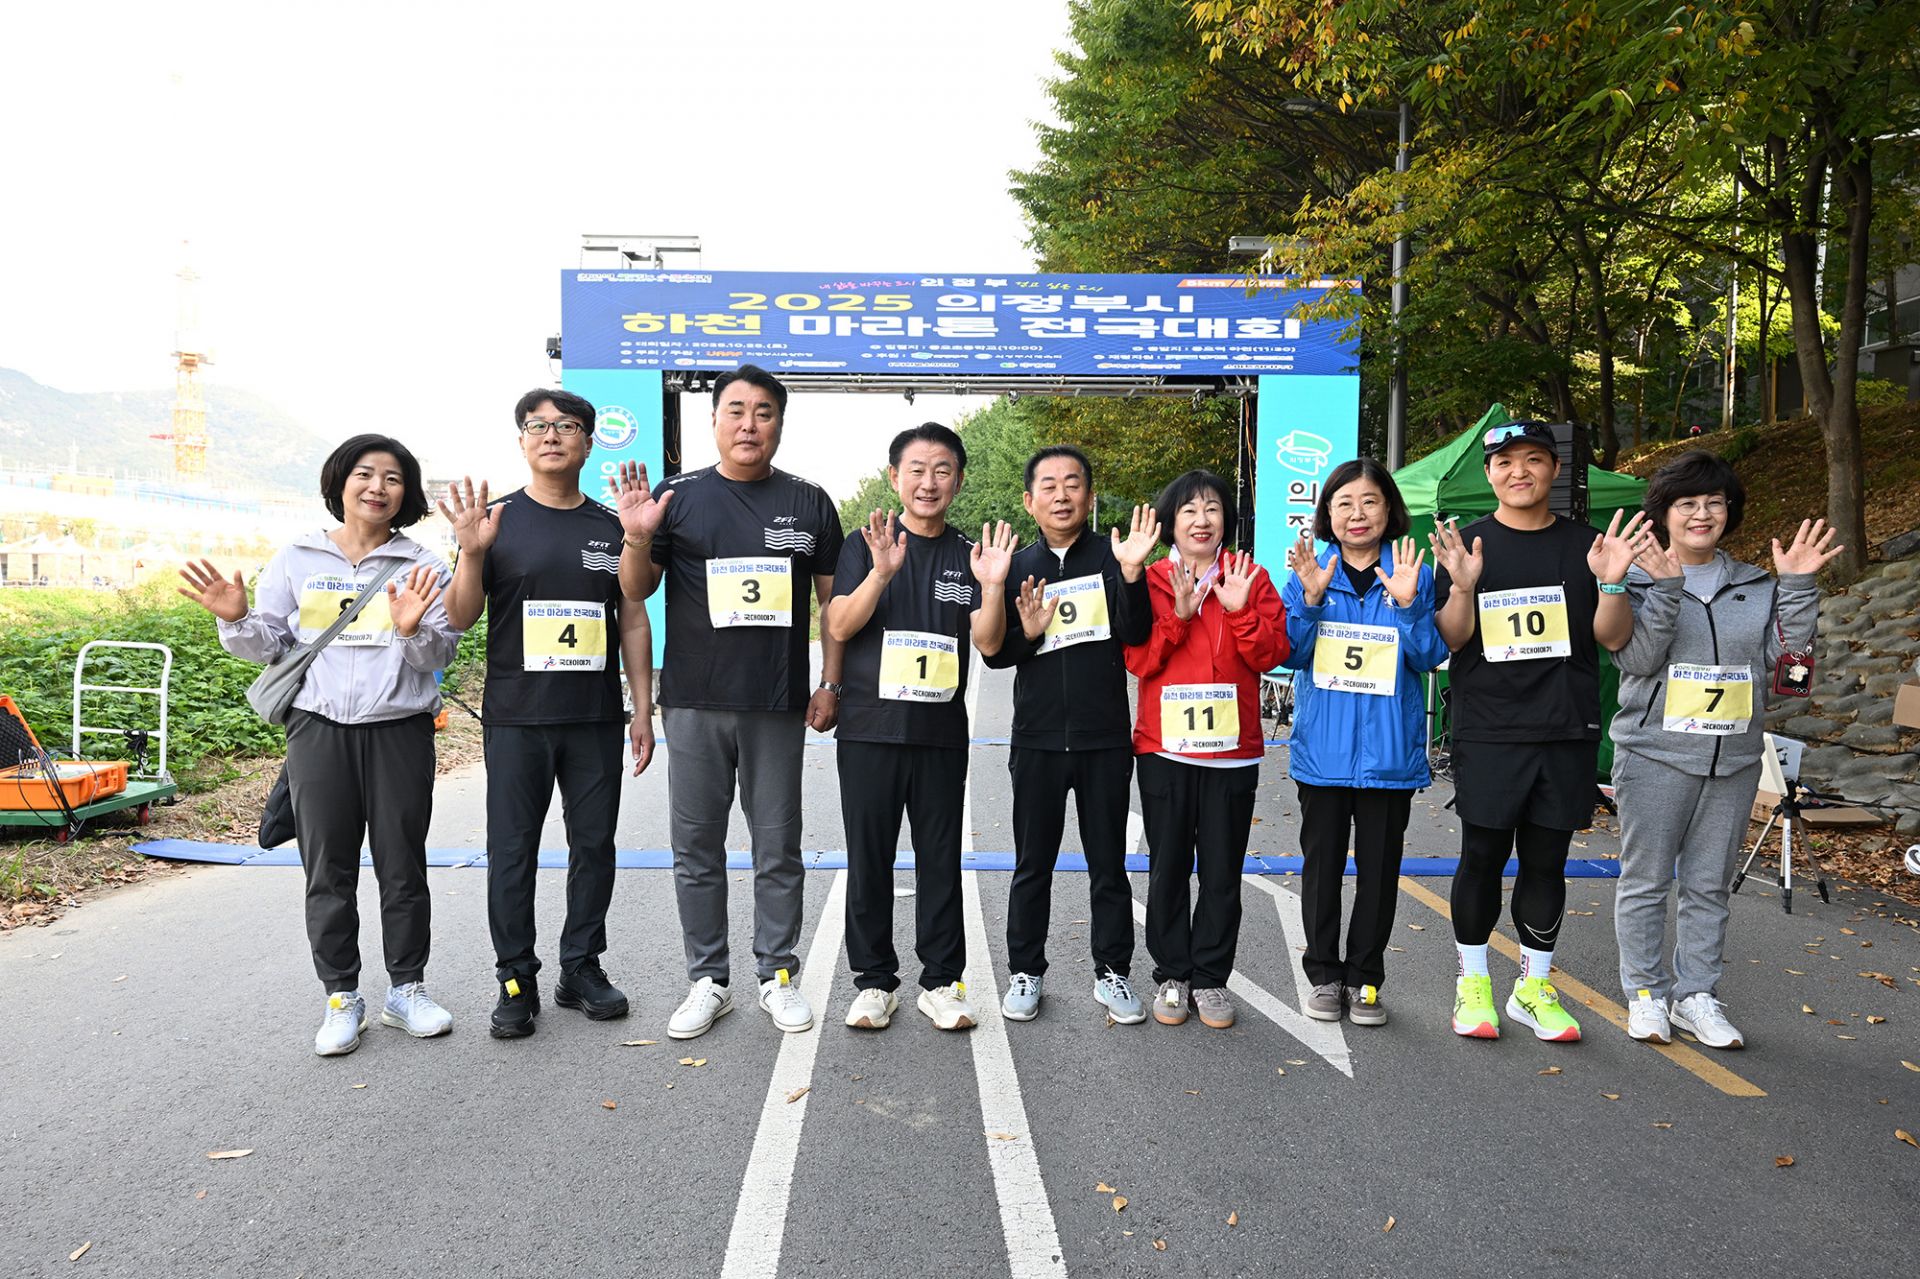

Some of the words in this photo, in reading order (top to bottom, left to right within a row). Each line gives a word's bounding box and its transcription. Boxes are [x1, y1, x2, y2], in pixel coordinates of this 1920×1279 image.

[728, 292, 913, 312] 2025
[936, 294, 1193, 313] 의정부시
[621, 312, 761, 335] 하천
[789, 315, 999, 338] 마라톤
[1020, 317, 1300, 340] 전국대회
[712, 565, 728, 574] 하천
[729, 564, 754, 573] 마라톤
[756, 564, 787, 573] 전국대회
[307, 582, 325, 590] 하천
[327, 581, 354, 591] 마라톤
[741, 579, 760, 603] 3
[1069, 581, 1100, 593] 전국대회
[1484, 600, 1500, 609] 하천
[1502, 597, 1528, 605] 마라톤
[1530, 594, 1561, 604] 전국대회
[528, 608, 545, 616] 하천
[547, 608, 572, 616] 마라톤
[574, 608, 602, 618] 전국대회
[744, 614, 776, 622] 국대이야기
[1058, 601, 1077, 624] 9
[1507, 610, 1545, 637] 10
[558, 623, 578, 648] 4
[1065, 630, 1095, 640] 국대이야기
[1319, 629, 1335, 637] 하천
[1336, 630, 1361, 639] 마라톤
[1362, 632, 1395, 643] 전국대회
[887, 638, 903, 646] 하천
[904, 639, 928, 648] 마라톤
[929, 641, 955, 653] 전국대회
[1520, 646, 1553, 655] 국대이야기
[1344, 645, 1363, 671] 5
[916, 655, 927, 679] 1
[1673, 670, 1692, 679] 하천
[1694, 671, 1720, 681] 마라톤
[1720, 672, 1748, 680] 전국대회
[1343, 680, 1376, 689] 국대이야기
[912, 690, 942, 699] 국대이야기
[1164, 692, 1178, 700] 하천
[1205, 690, 1234, 699] 전국대회
[1704, 688, 1725, 712] 7
[1183, 706, 1214, 730] 11
[1702, 722, 1735, 731] 국대이야기
[1192, 740, 1224, 748] 국대이야기
